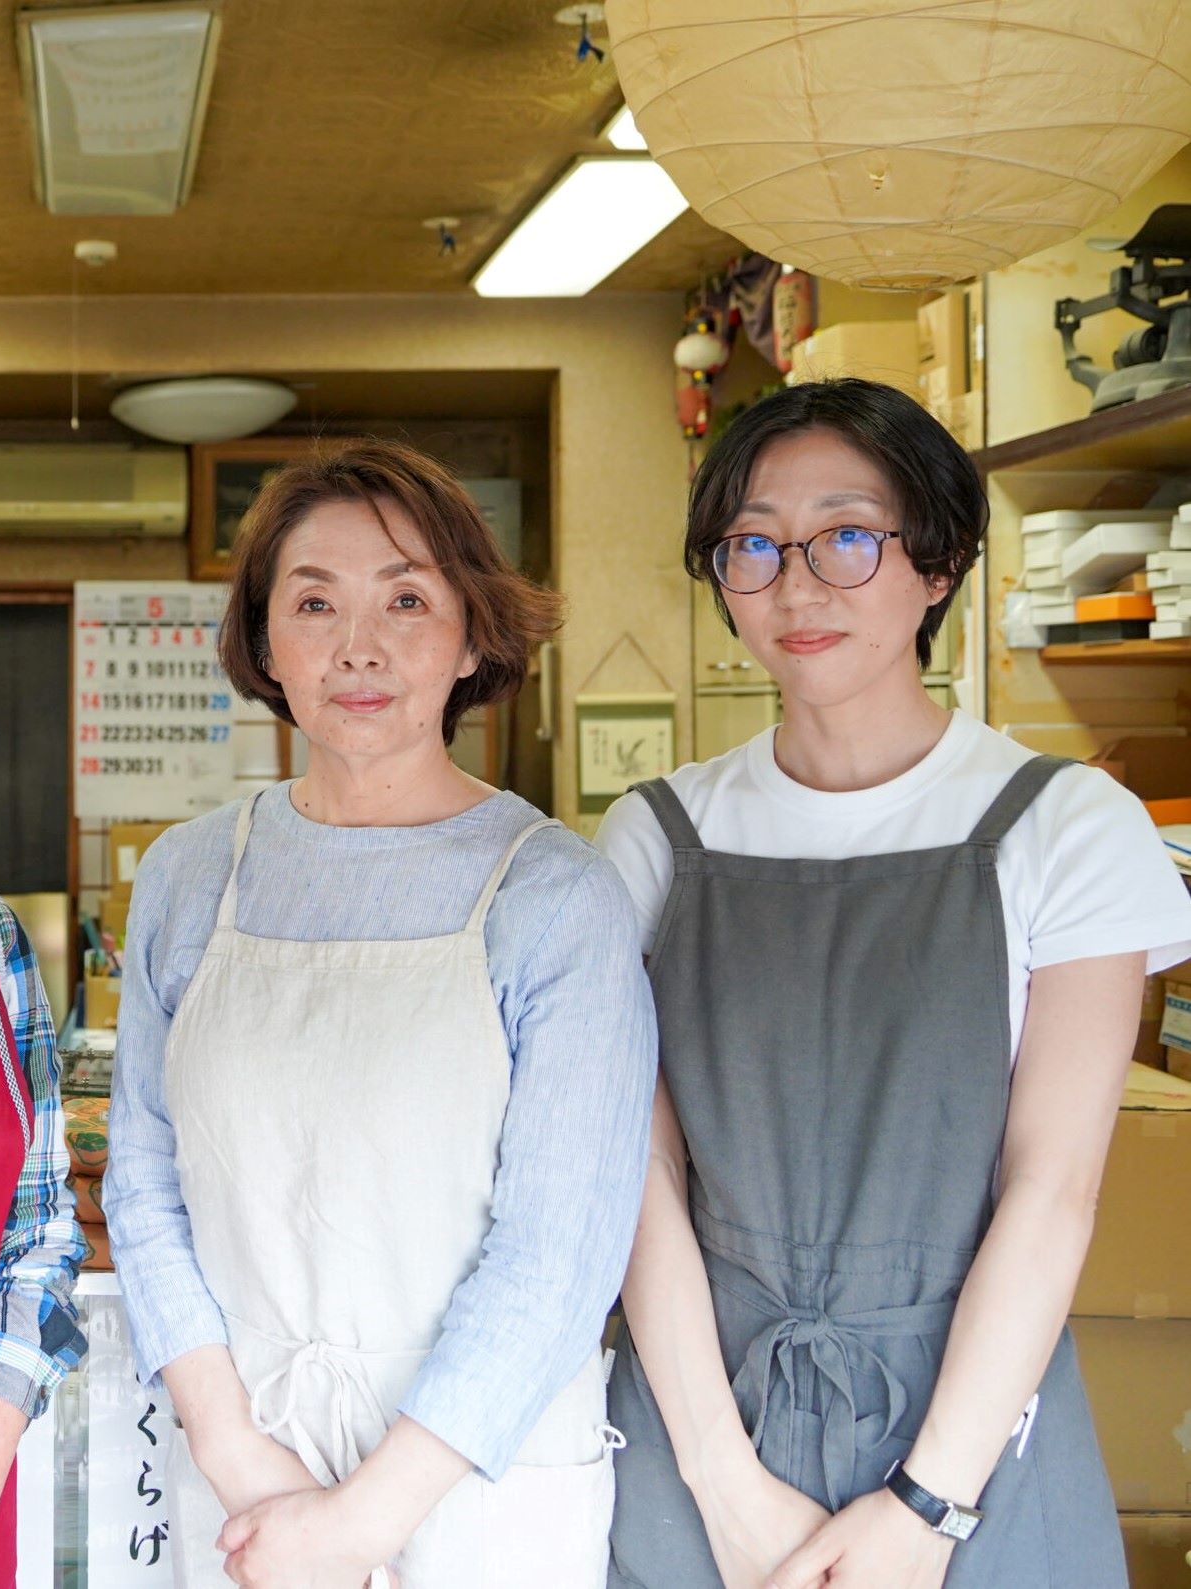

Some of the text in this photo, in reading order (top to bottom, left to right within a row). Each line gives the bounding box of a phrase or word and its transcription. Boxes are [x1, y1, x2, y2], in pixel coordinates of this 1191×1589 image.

[108, 628, 116, 645] 1
[128, 628, 138, 645] 2
[172, 628, 182, 645] 4
[84, 661, 95, 677] 7
[106, 661, 116, 677] 8
[128, 661, 139, 677] 9
[147, 661, 165, 677] 10
[169, 661, 186, 677] 11
[189, 661, 208, 677] 12
[81, 693, 230, 710] 14 15 16 17 18 19 20
[80, 726, 230, 742] 21 22 23 24 25 26 27
[80, 757, 100, 774] 28
[102, 757, 121, 774] 29
[124, 757, 142, 774] 30
[129, 1372, 170, 1567] くらげ
